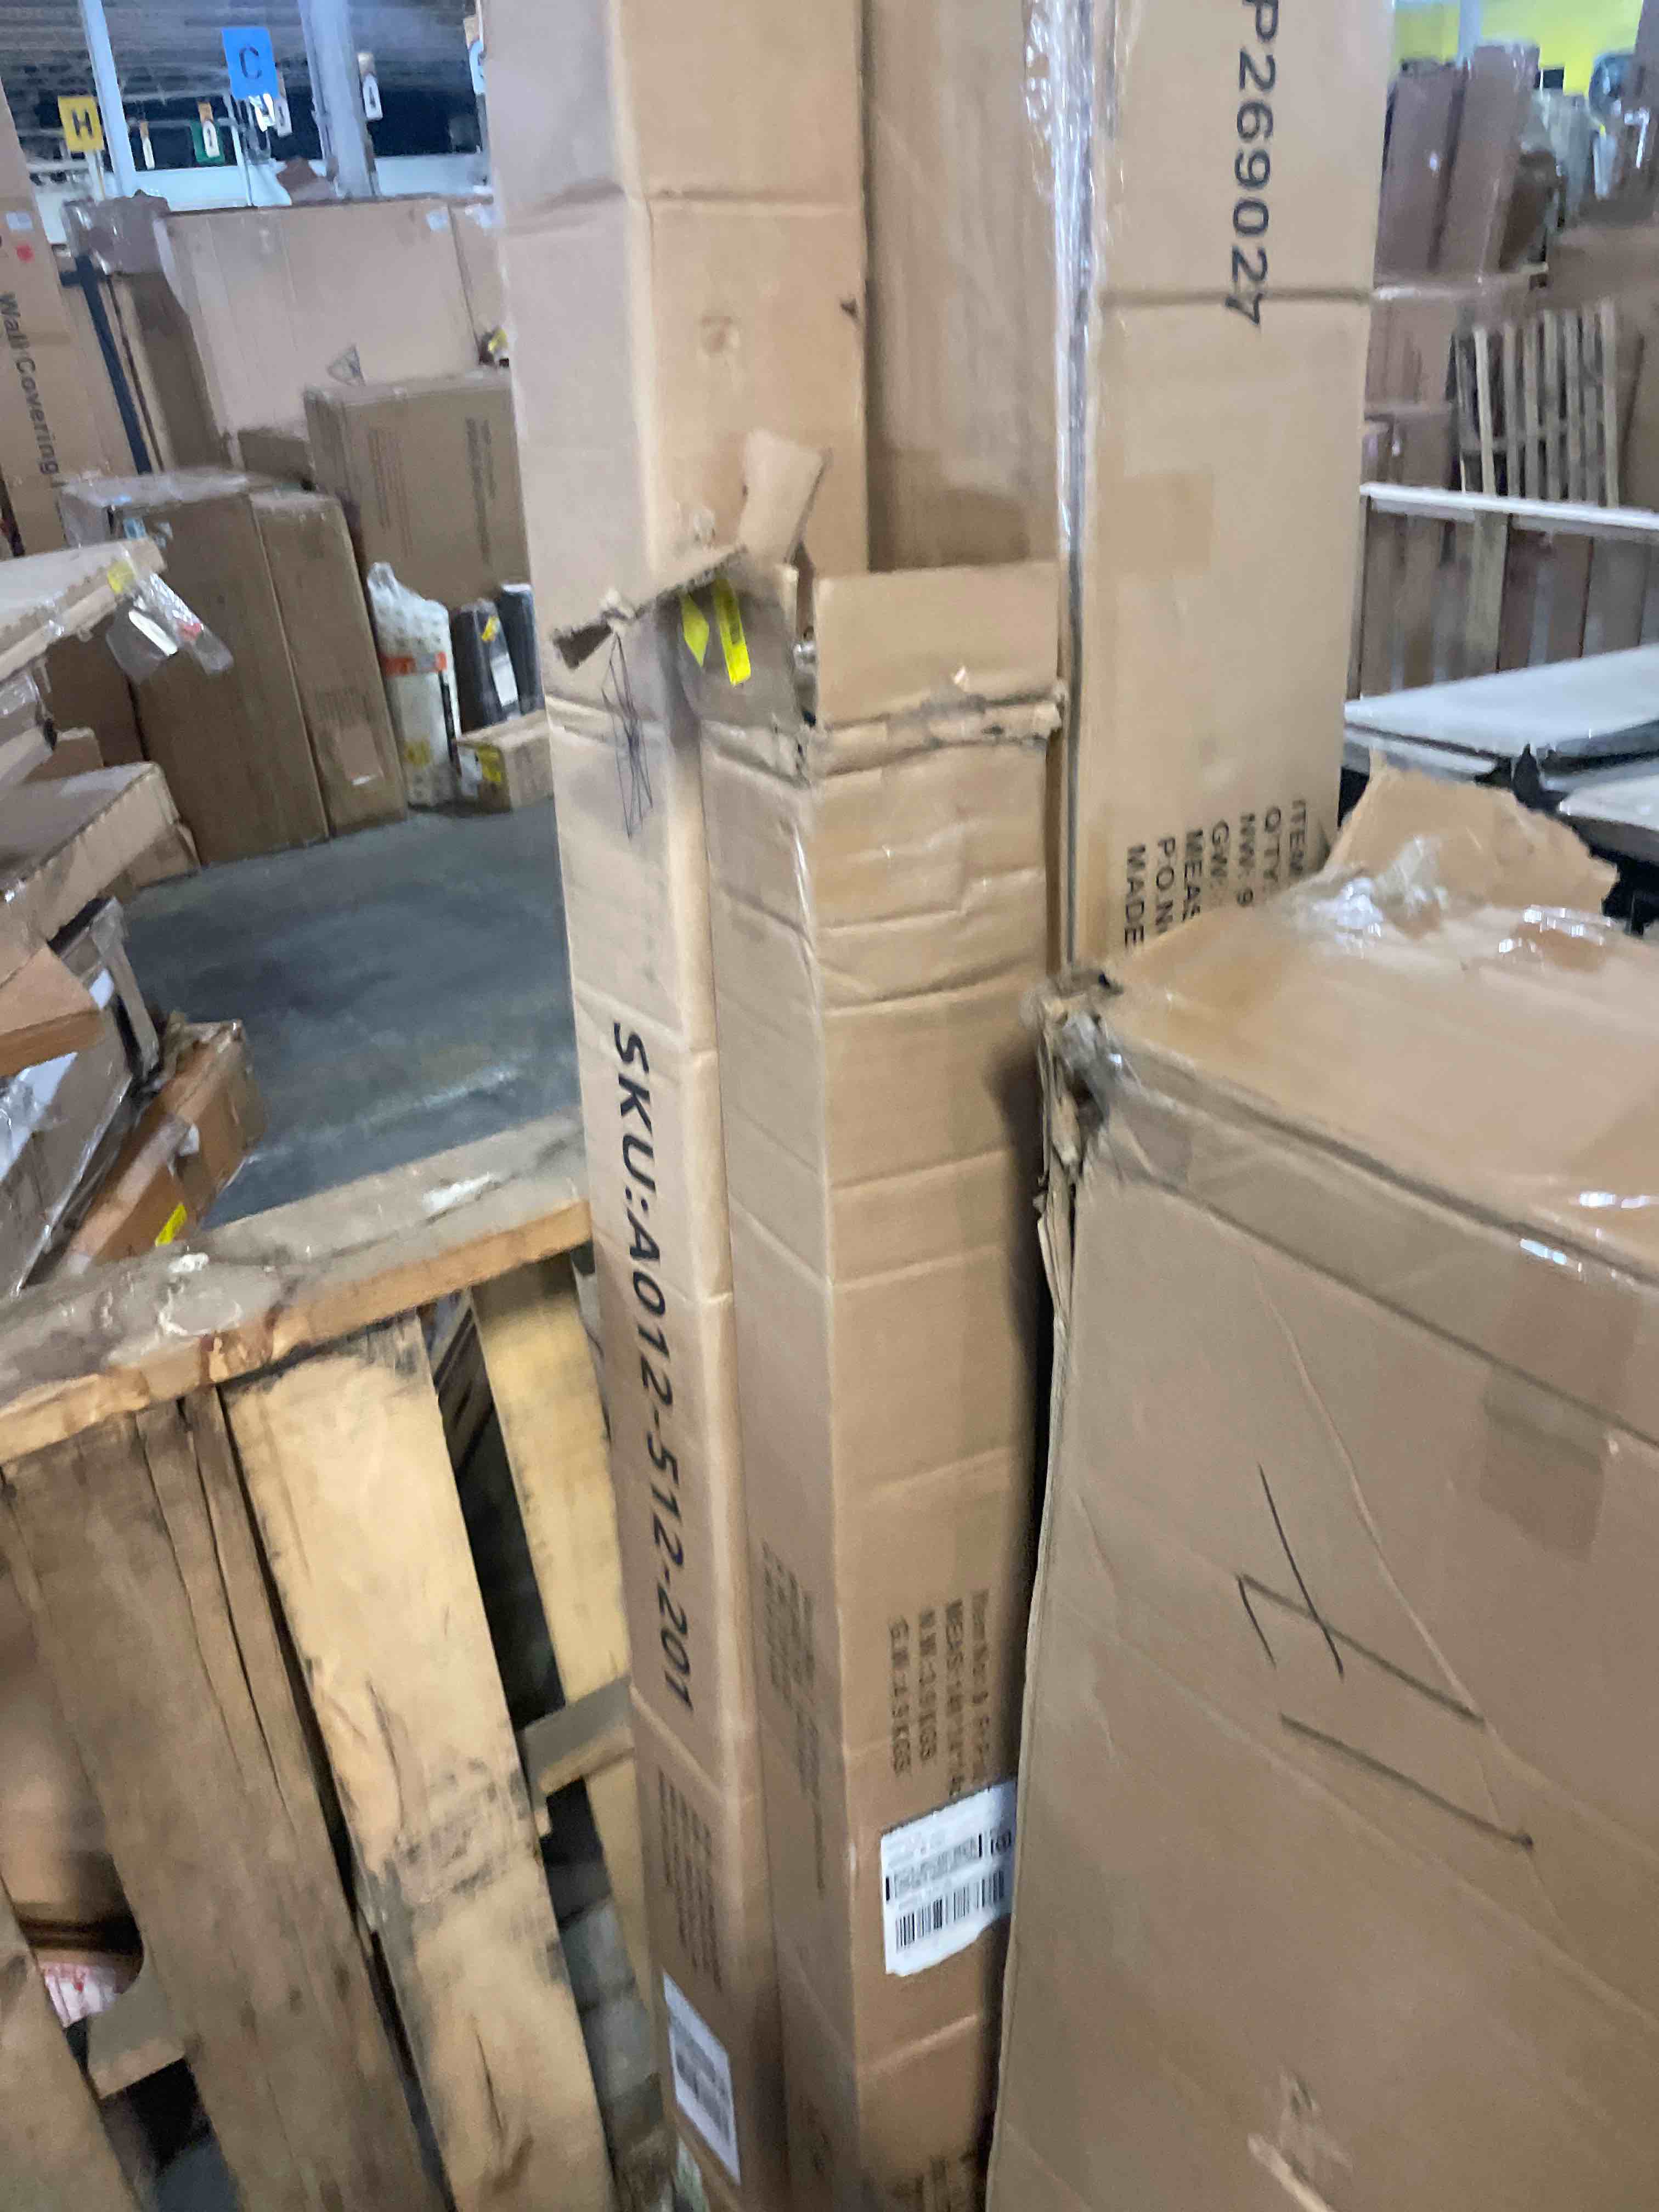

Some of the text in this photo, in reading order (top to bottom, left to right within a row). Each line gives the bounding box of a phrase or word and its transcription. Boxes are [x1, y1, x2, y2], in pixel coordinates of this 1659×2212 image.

[238, 45, 263, 80] C
[71, 109, 94, 140] H
[1224, 0, 1279, 325] P269027
[16, 357, 60, 475] Covering
[613, 1022, 694, 1712] SKU:A012-512-201
